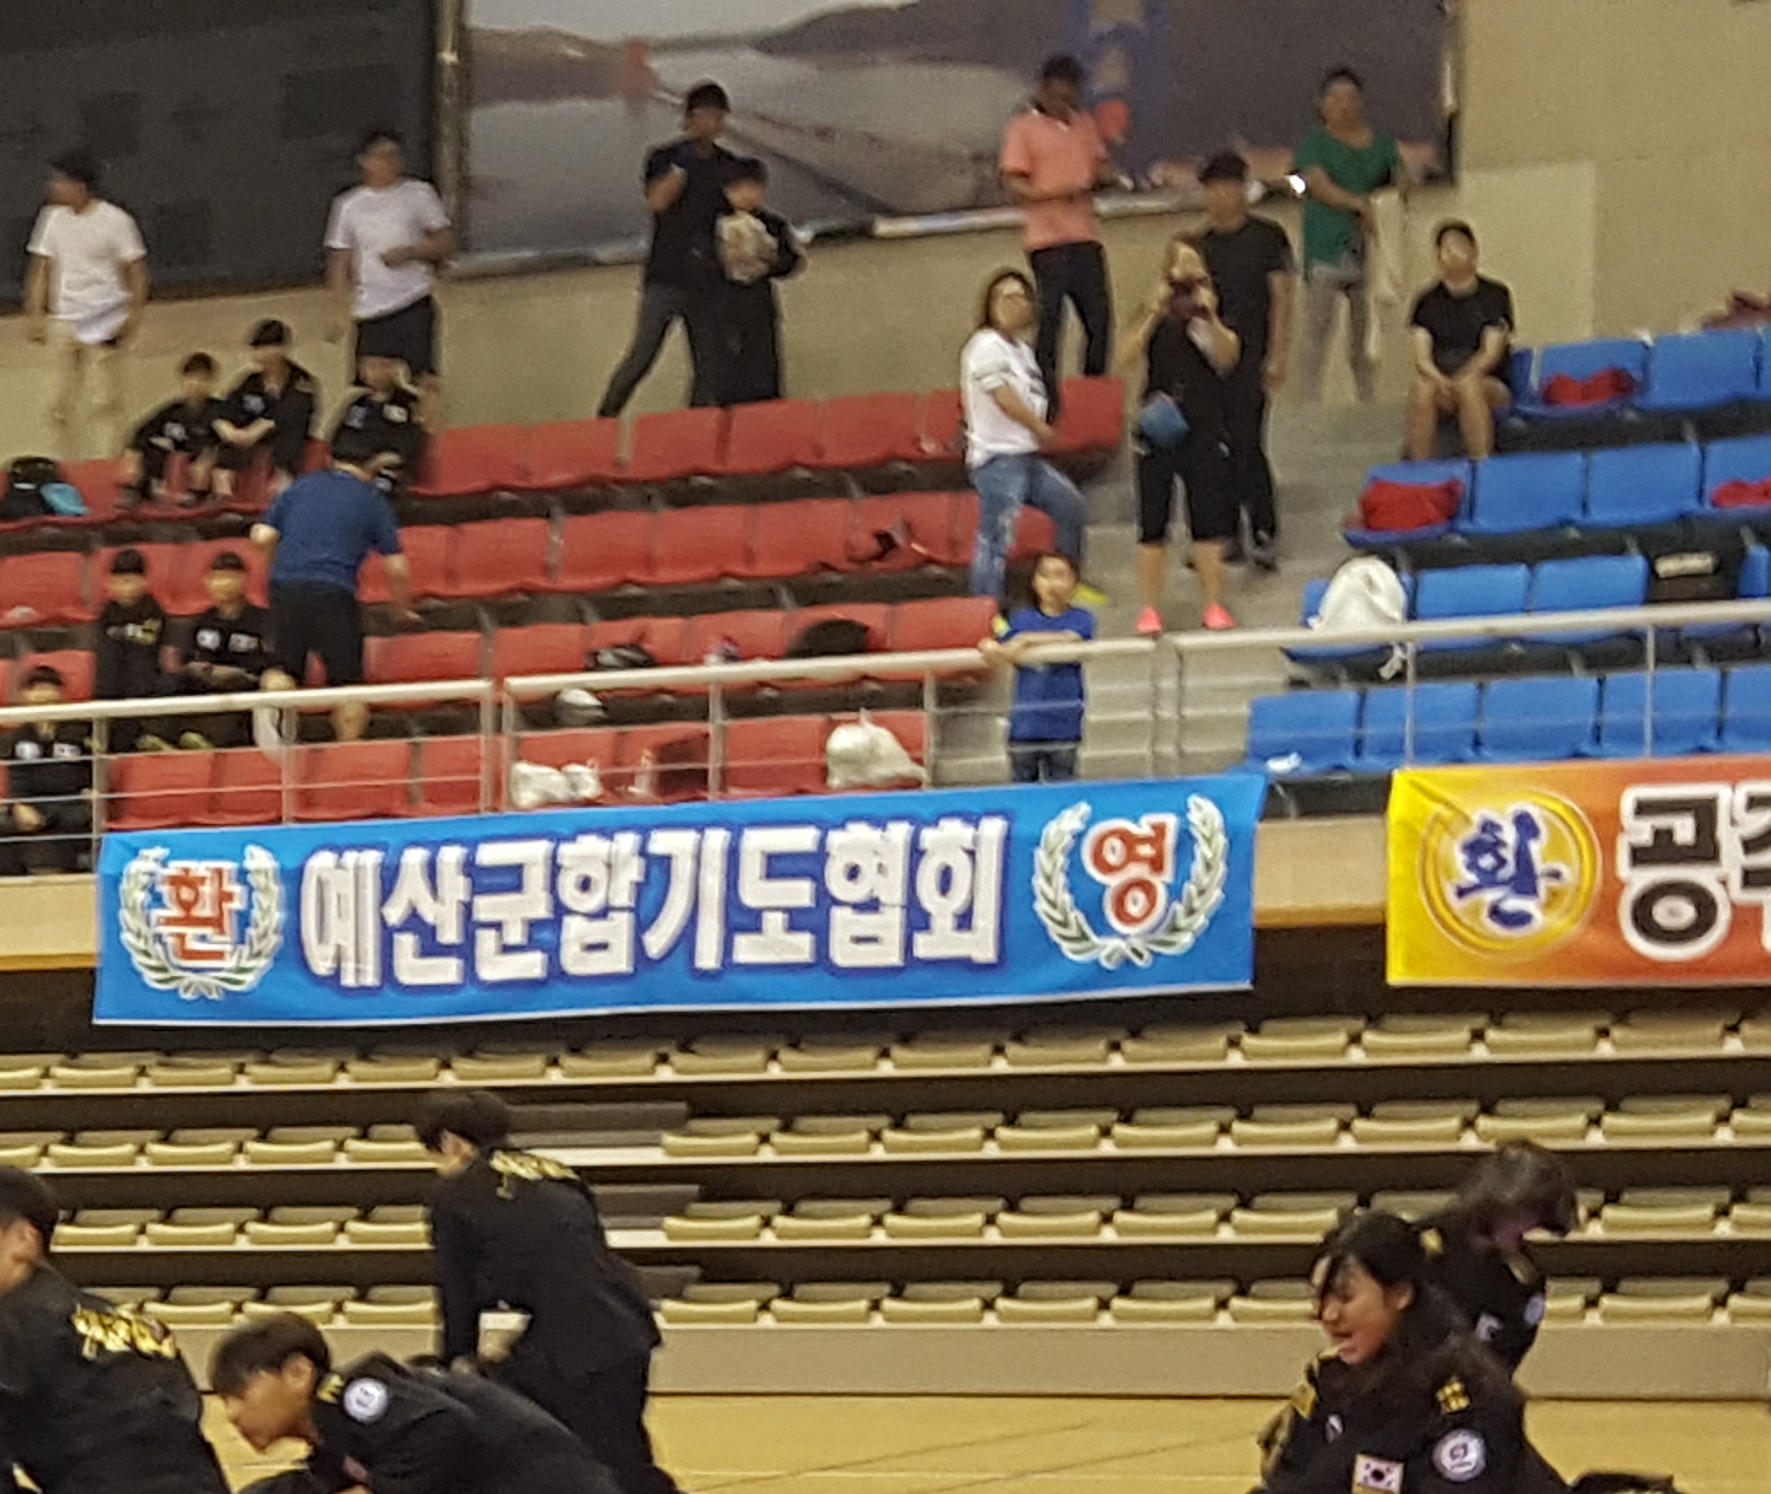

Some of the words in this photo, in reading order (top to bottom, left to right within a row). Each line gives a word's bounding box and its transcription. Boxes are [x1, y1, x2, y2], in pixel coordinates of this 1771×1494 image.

[157, 863, 238, 962] 환
[302, 816, 1007, 988] 예산군합기도협회
[1086, 814, 1171, 932] 영
[1455, 809, 1563, 930] 환
